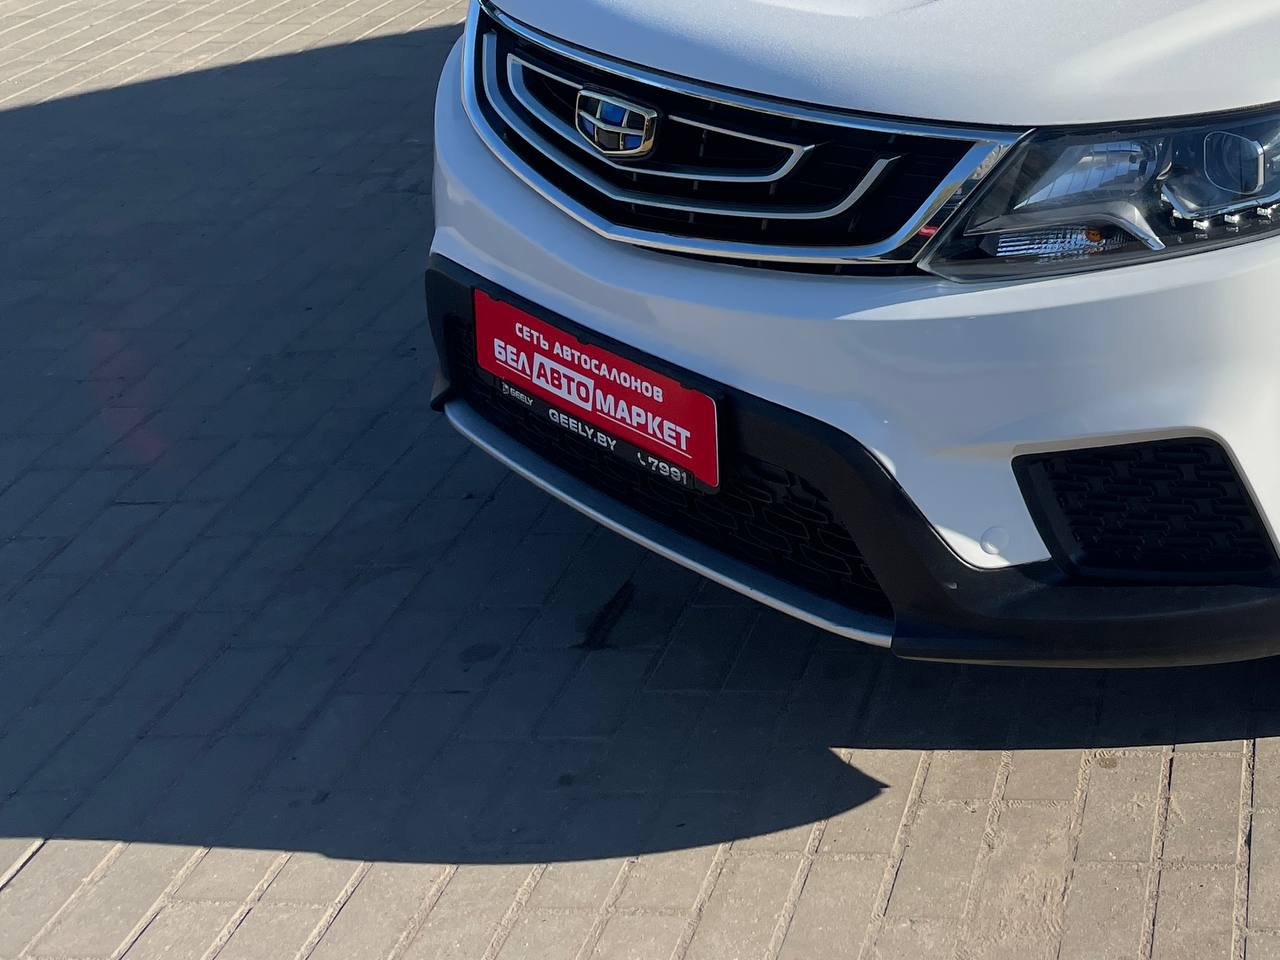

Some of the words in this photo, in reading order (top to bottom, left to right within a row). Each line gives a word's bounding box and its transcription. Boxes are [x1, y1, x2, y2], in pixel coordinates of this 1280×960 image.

[493, 337, 532, 376] БЕЛ
[535, 360, 591, 405] АВТО
[595, 388, 691, 451] МАРКЕТ
[515, 322, 549, 351] СЕТЬ
[553, 341, 664, 403] АВТОСАЛОНОВ
[510, 387, 534, 407] GEELY
[548, 408, 617, 452] GEELY.BY
[648, 456, 687, 485] 7991
